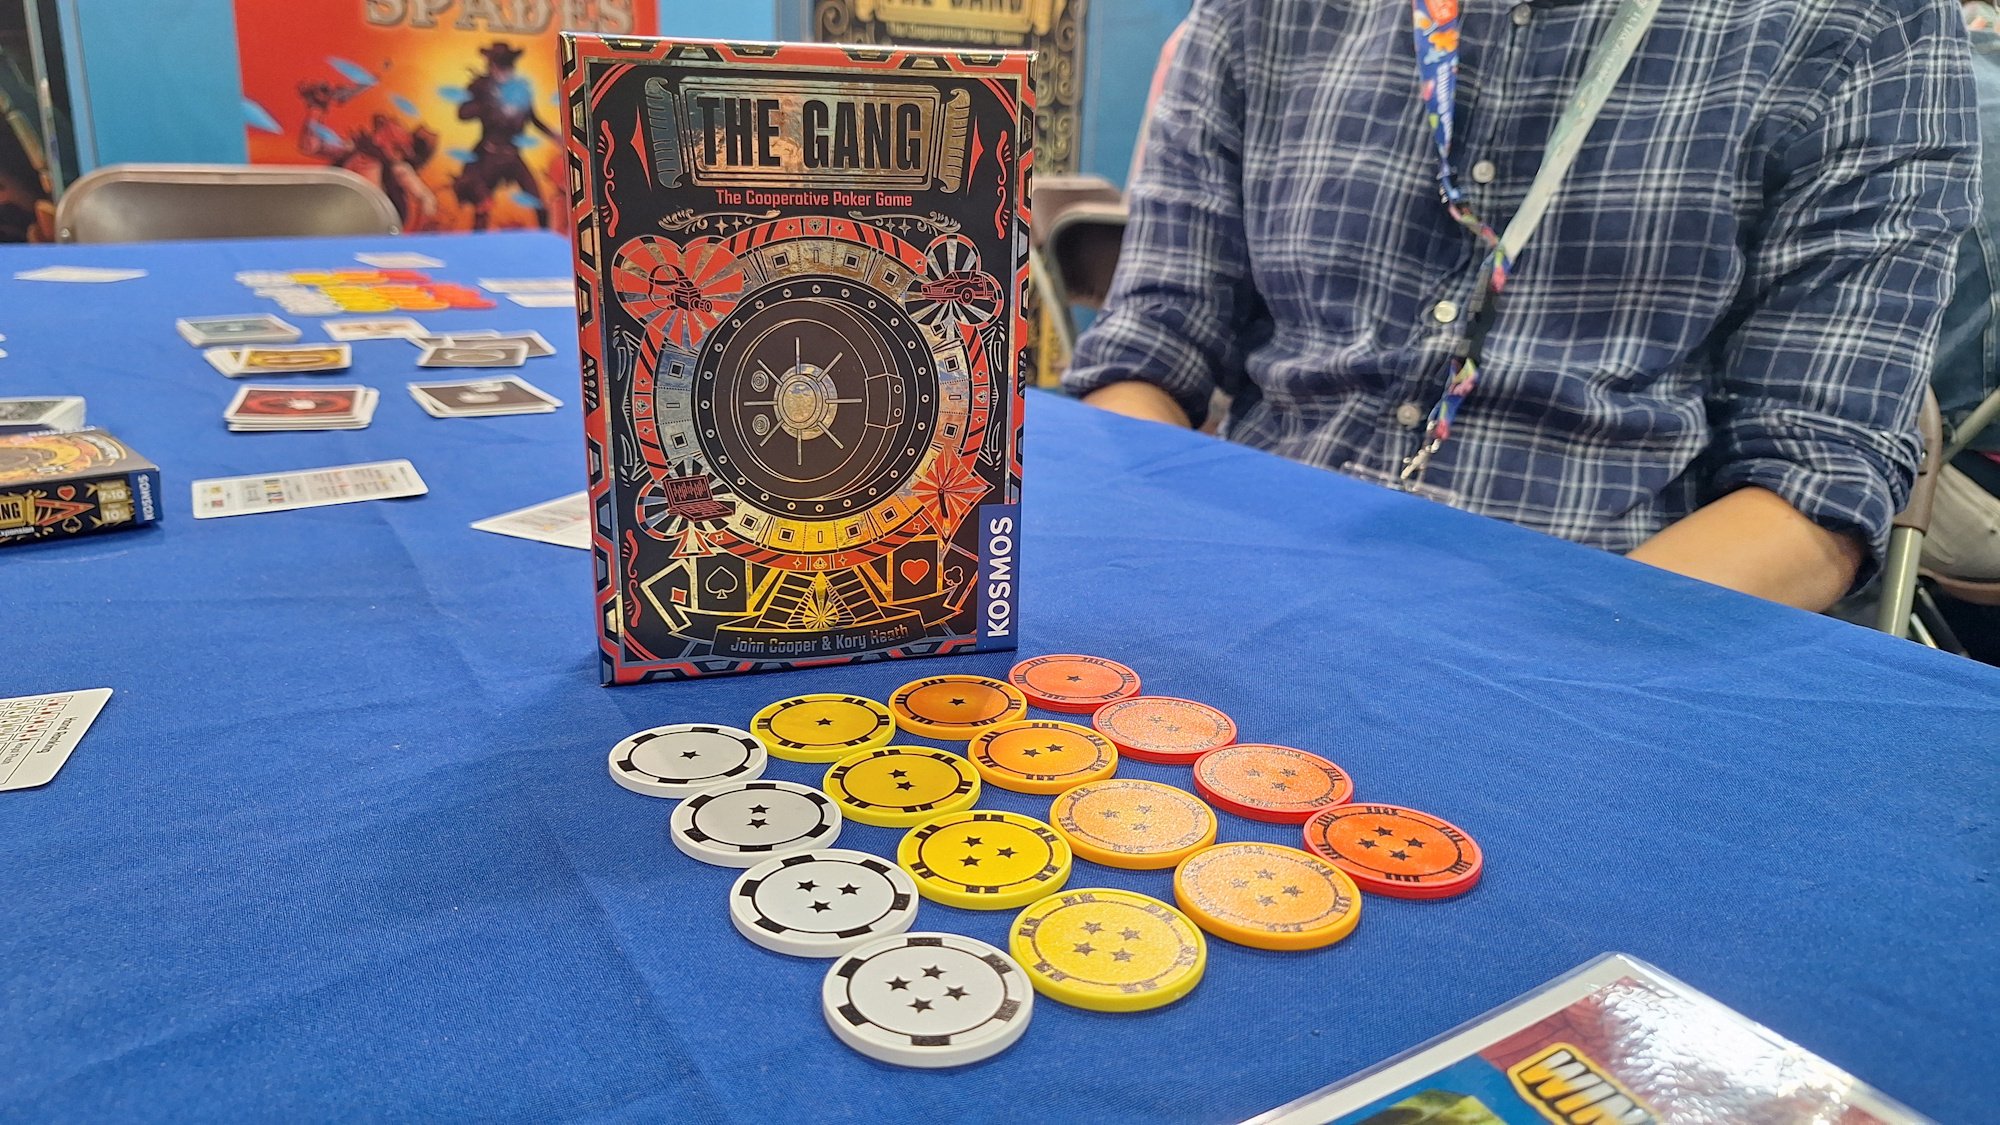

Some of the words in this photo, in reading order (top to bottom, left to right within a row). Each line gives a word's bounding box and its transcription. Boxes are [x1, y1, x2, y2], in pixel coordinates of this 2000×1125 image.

[696, 96, 781, 168] THE
[802, 99, 922, 171] GANG
[715, 189, 742, 205] The
[745, 190, 829, 208] Cooperative
[833, 191, 872, 207] Poker
[875, 193, 913, 207] Game
[0, 502, 21, 521] NG
[138, 474, 155, 520] KOSMOS
[987, 516, 1013, 638] KOSMOS
[730, 636, 766, 653] John
[768, 638, 817, 656] Cooper
[821, 637, 832, 651] &
[835, 634, 867, 650] Kory
[870, 624, 910, 645] Heath
